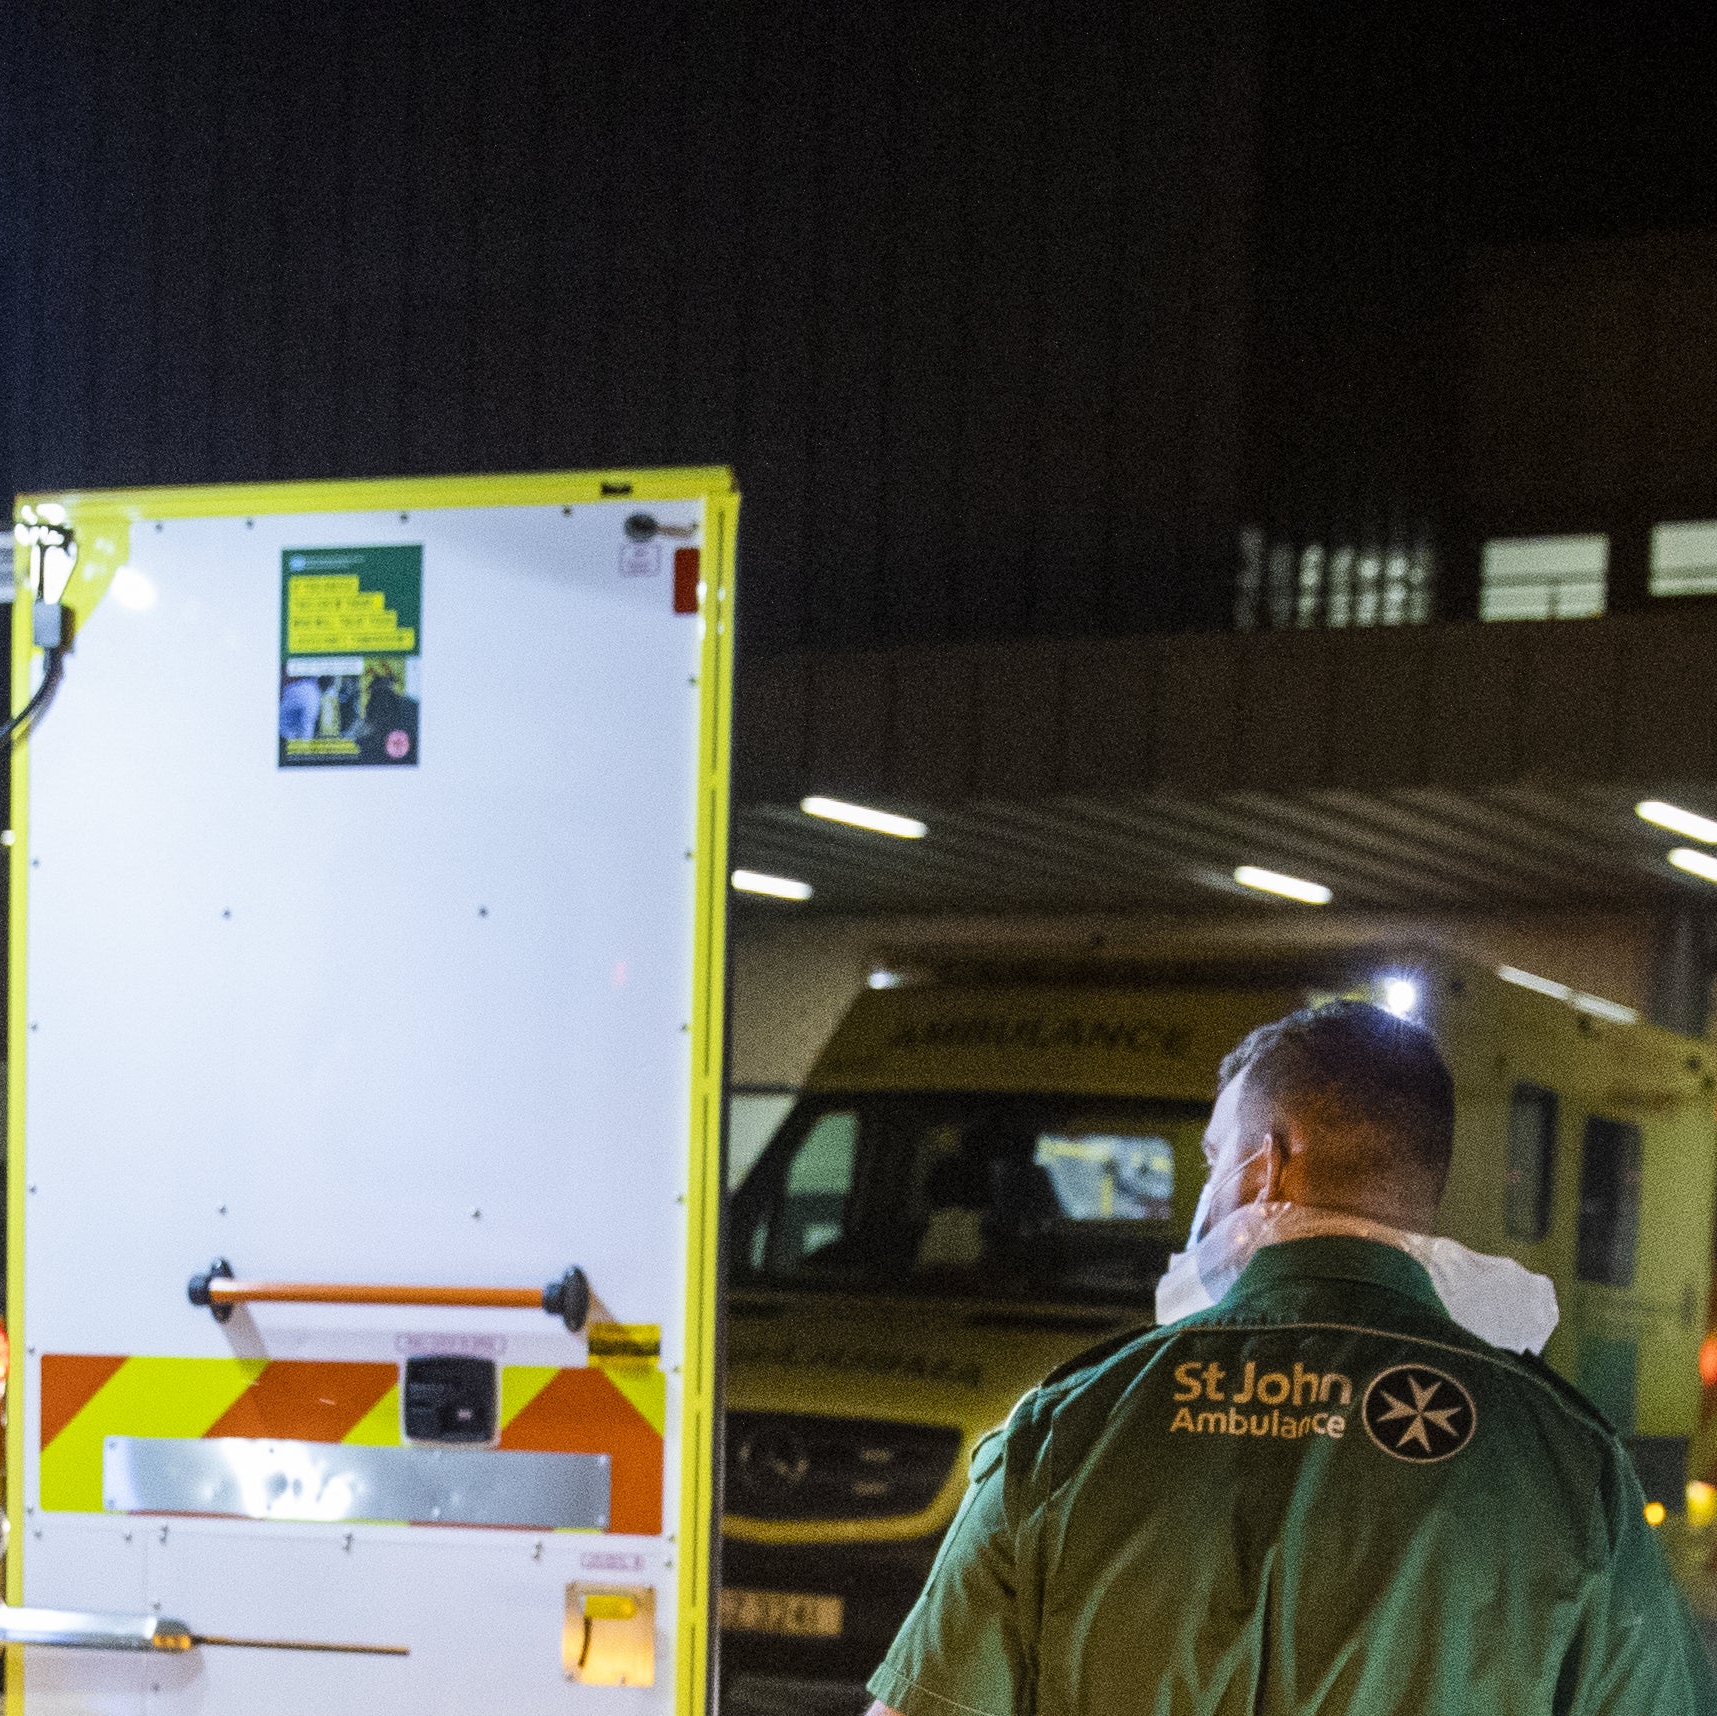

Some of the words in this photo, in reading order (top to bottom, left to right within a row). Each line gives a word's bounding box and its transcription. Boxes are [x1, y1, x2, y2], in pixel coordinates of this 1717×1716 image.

[1173, 1362, 1226, 1403] St
[1233, 1361, 1354, 1407] John
[1169, 1407, 1347, 1440] Ambulance
